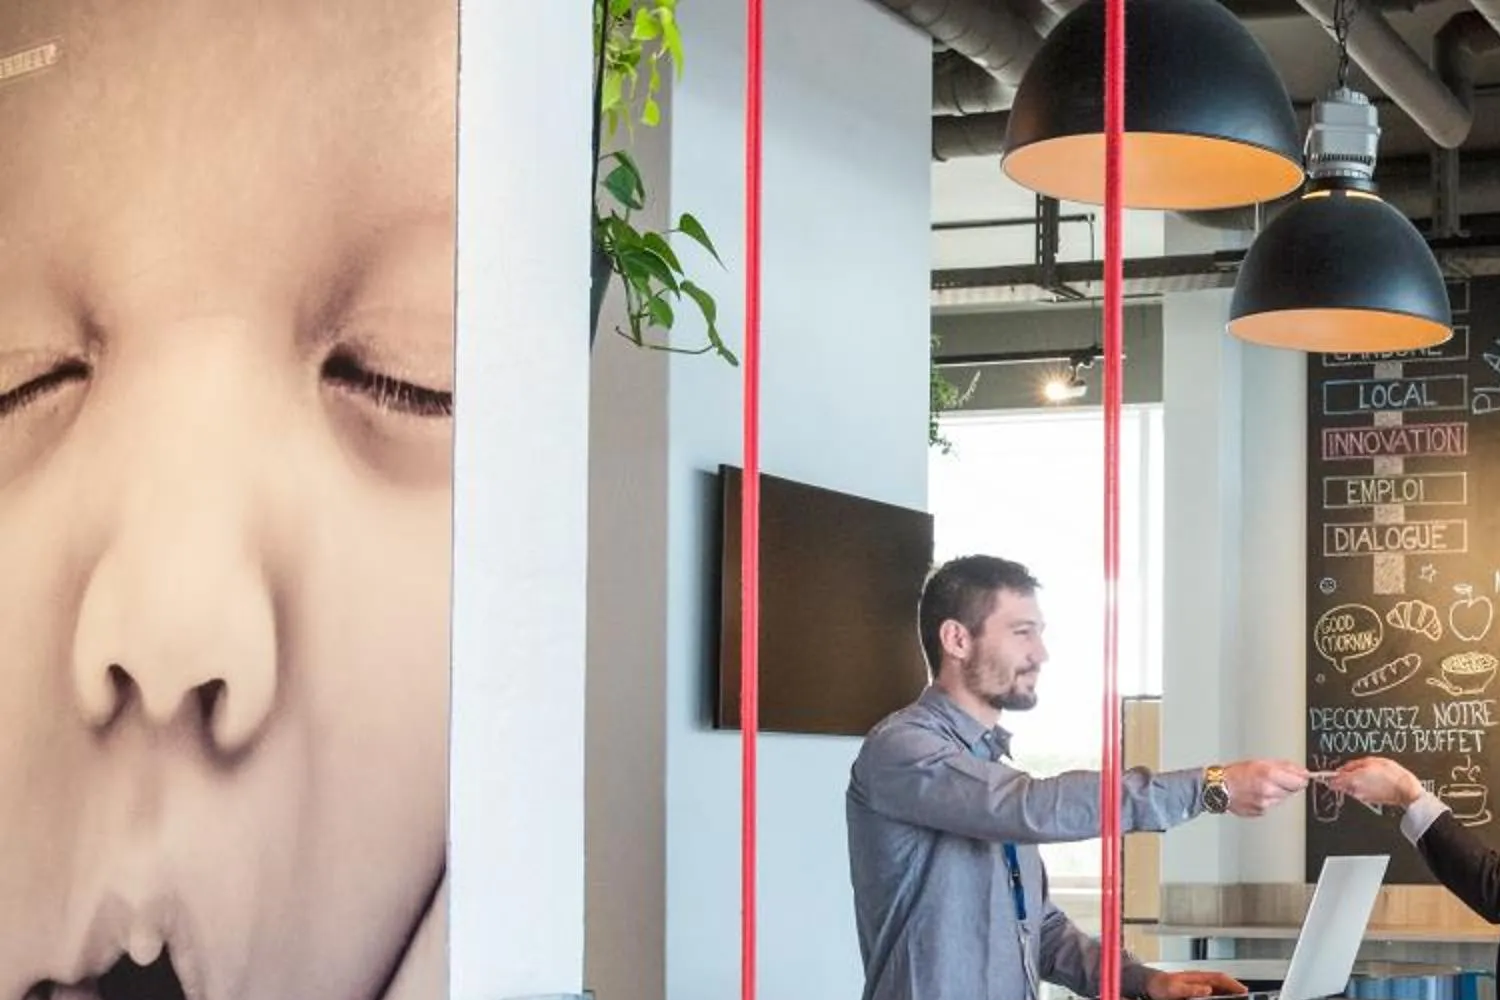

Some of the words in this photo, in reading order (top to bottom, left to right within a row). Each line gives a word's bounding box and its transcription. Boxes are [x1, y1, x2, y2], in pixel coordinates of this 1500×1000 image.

[1359, 382, 1437, 408] LOCAL
[1329, 427, 1461, 455] INNOVATION
[1347, 478, 1424, 503] EMPLOI
[1335, 525, 1448, 551] DIALOGUE
[1321, 614, 1355, 634] GOOD
[1309, 706, 1421, 730] DECOUVREZ
[1433, 700, 1500, 727] NOTRE
[1320, 731, 1407, 752] NOUVEAU
[1412, 729, 1486, 752] BUFFET
